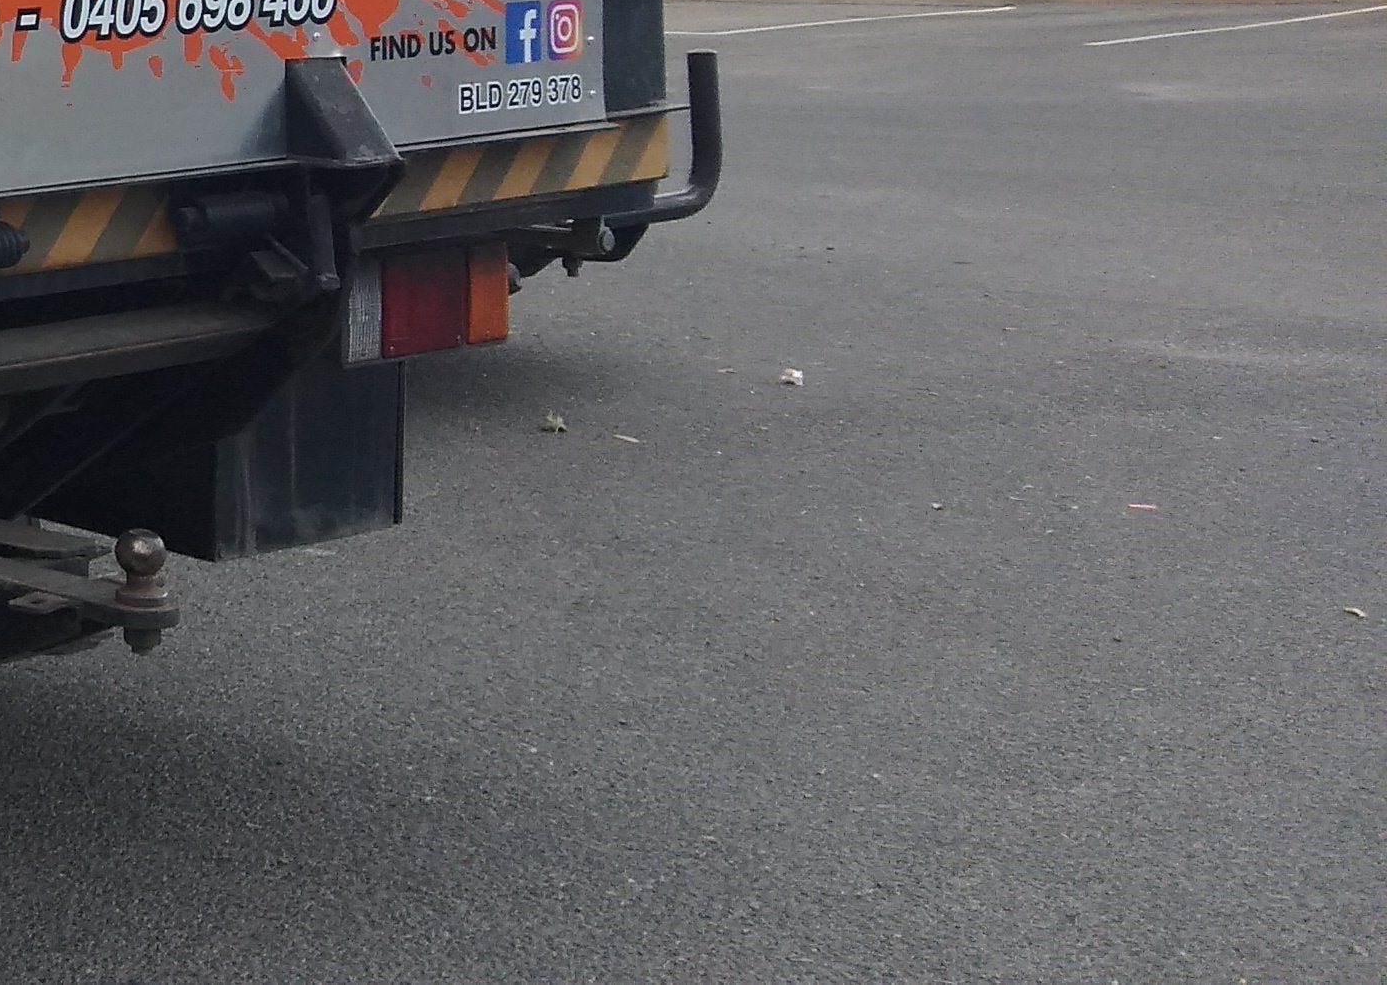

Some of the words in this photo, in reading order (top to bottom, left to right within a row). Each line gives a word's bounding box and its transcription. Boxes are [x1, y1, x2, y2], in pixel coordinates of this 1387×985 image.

[370, 33, 422, 62] FIND
[429, 30, 456, 56] US
[463, 26, 497, 52] ON
[459, 83, 503, 113] BLD
[508, 78, 542, 107] 279
[547, 75, 583, 104] 378
